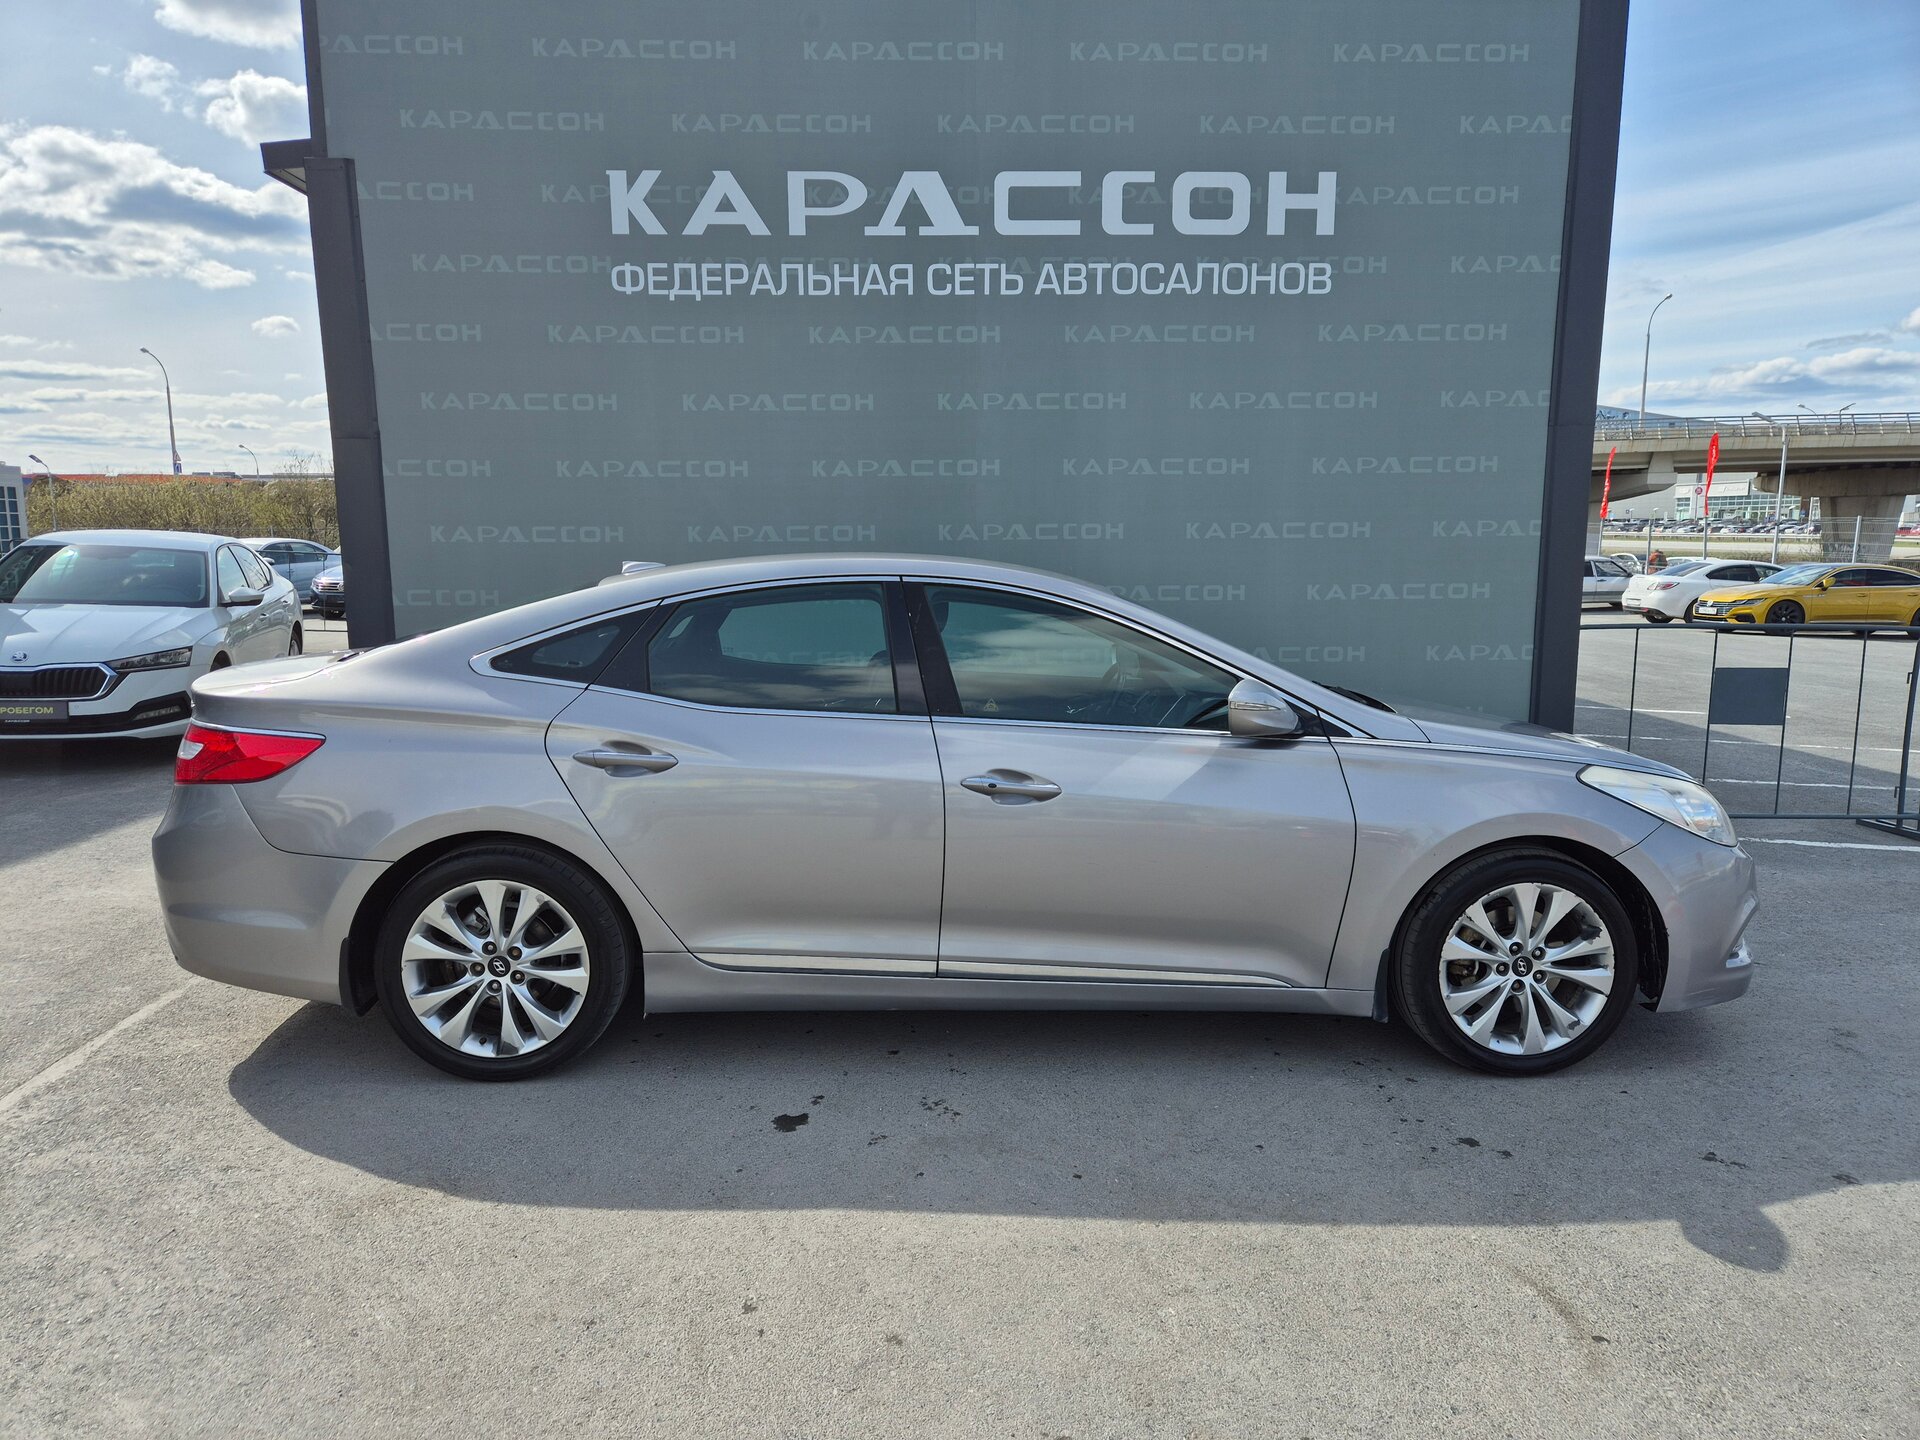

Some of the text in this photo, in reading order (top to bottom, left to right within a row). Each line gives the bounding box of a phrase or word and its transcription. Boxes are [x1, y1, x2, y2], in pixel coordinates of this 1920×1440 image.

[606, 171, 1336, 235] КАРЛССОН
[612, 263, 1331, 300] ФЕДЕРАЛЬНАЯ СЕТЬ АВТОСАЛОНОВ
